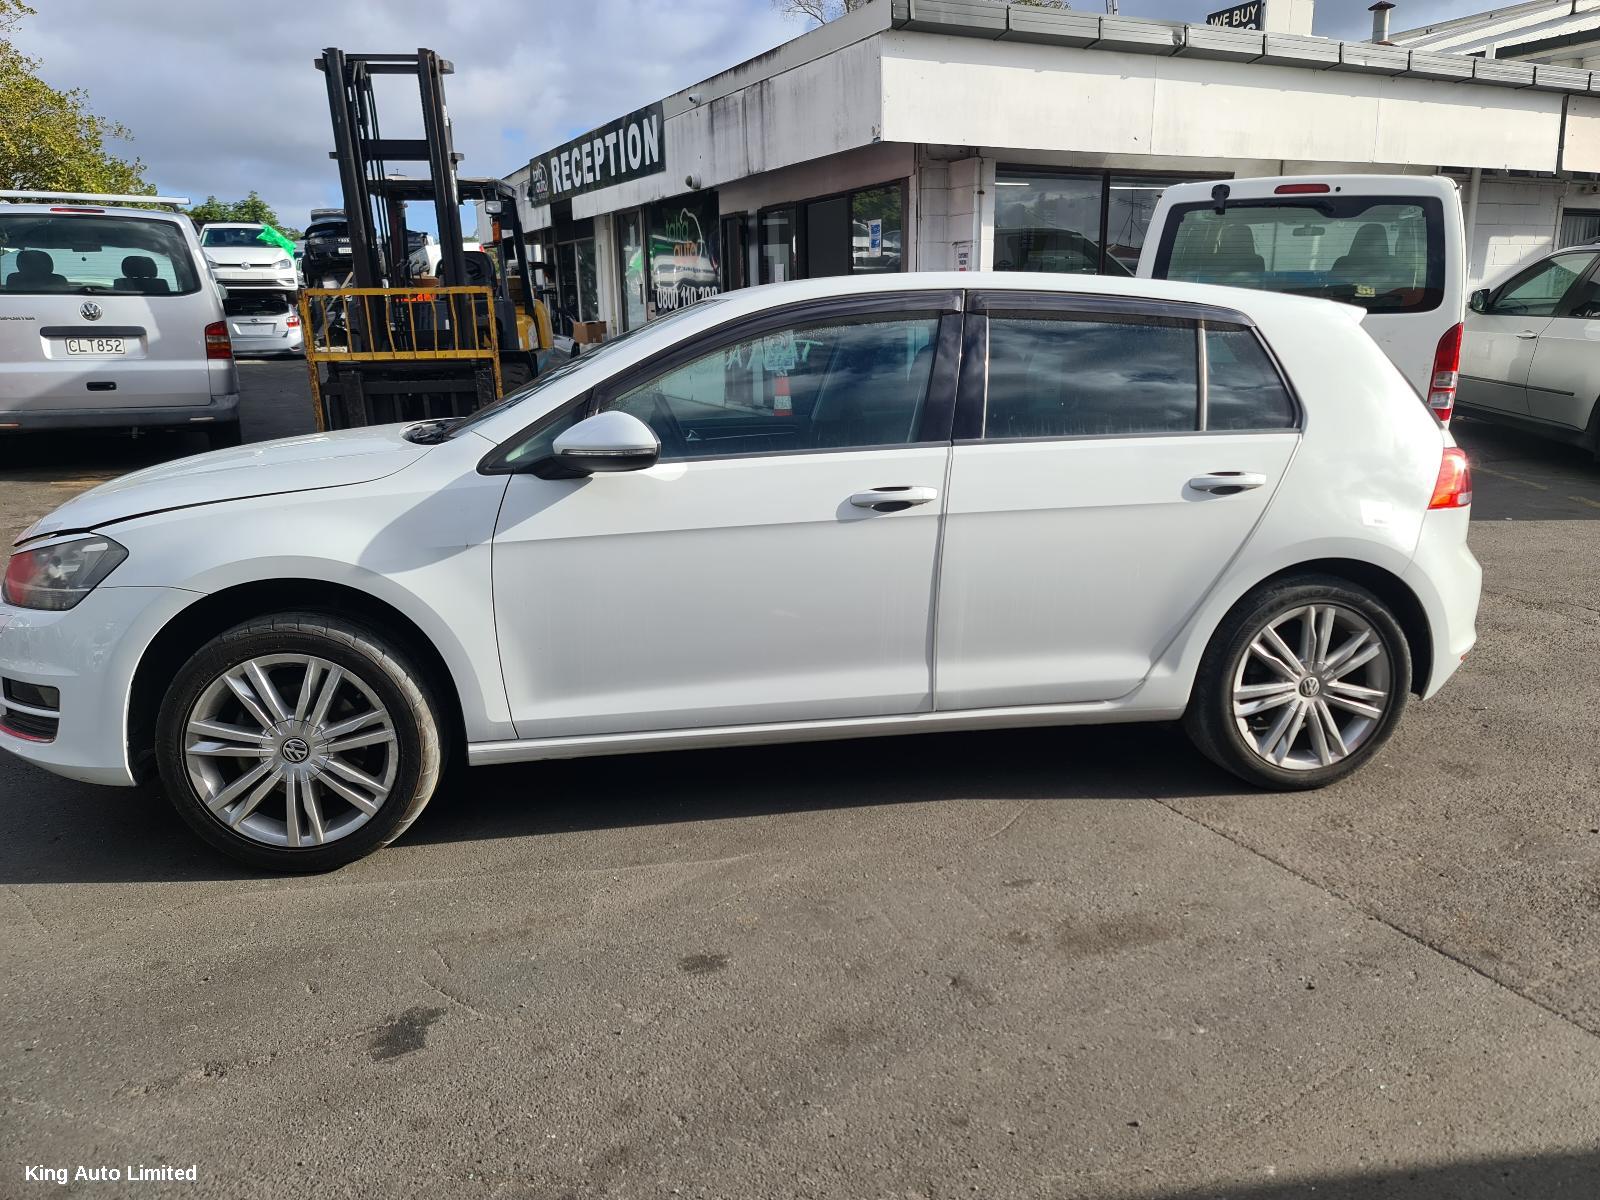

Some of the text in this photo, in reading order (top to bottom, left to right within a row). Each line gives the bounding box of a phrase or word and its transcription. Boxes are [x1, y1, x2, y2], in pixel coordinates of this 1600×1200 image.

[1210, 4, 1258, 28] WE BUY
[550, 114, 659, 195] RECEPTION
[657, 287, 679, 309] 0800
[681, 286, 697, 307] 110
[68, 338, 123, 353] CLT852
